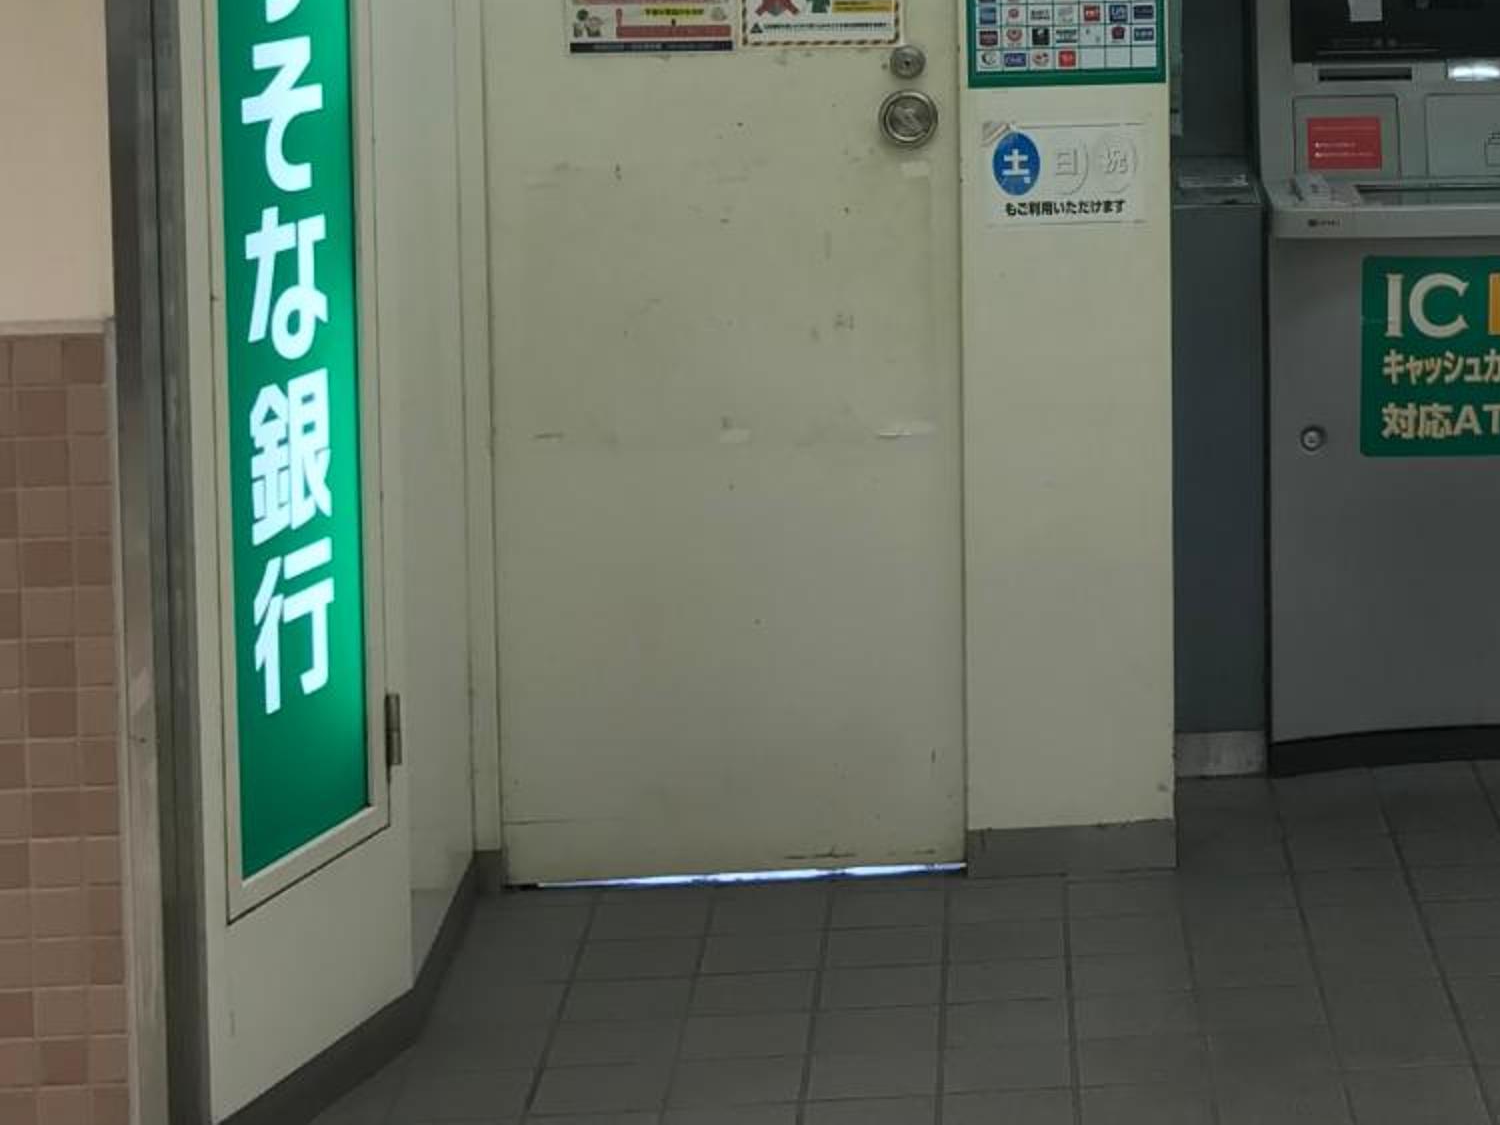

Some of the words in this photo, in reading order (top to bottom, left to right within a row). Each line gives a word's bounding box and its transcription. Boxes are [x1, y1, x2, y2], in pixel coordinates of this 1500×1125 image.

[1005, 199, 1127, 216] もご利用いただけます
[1384, 271, 1470, 339] IC
